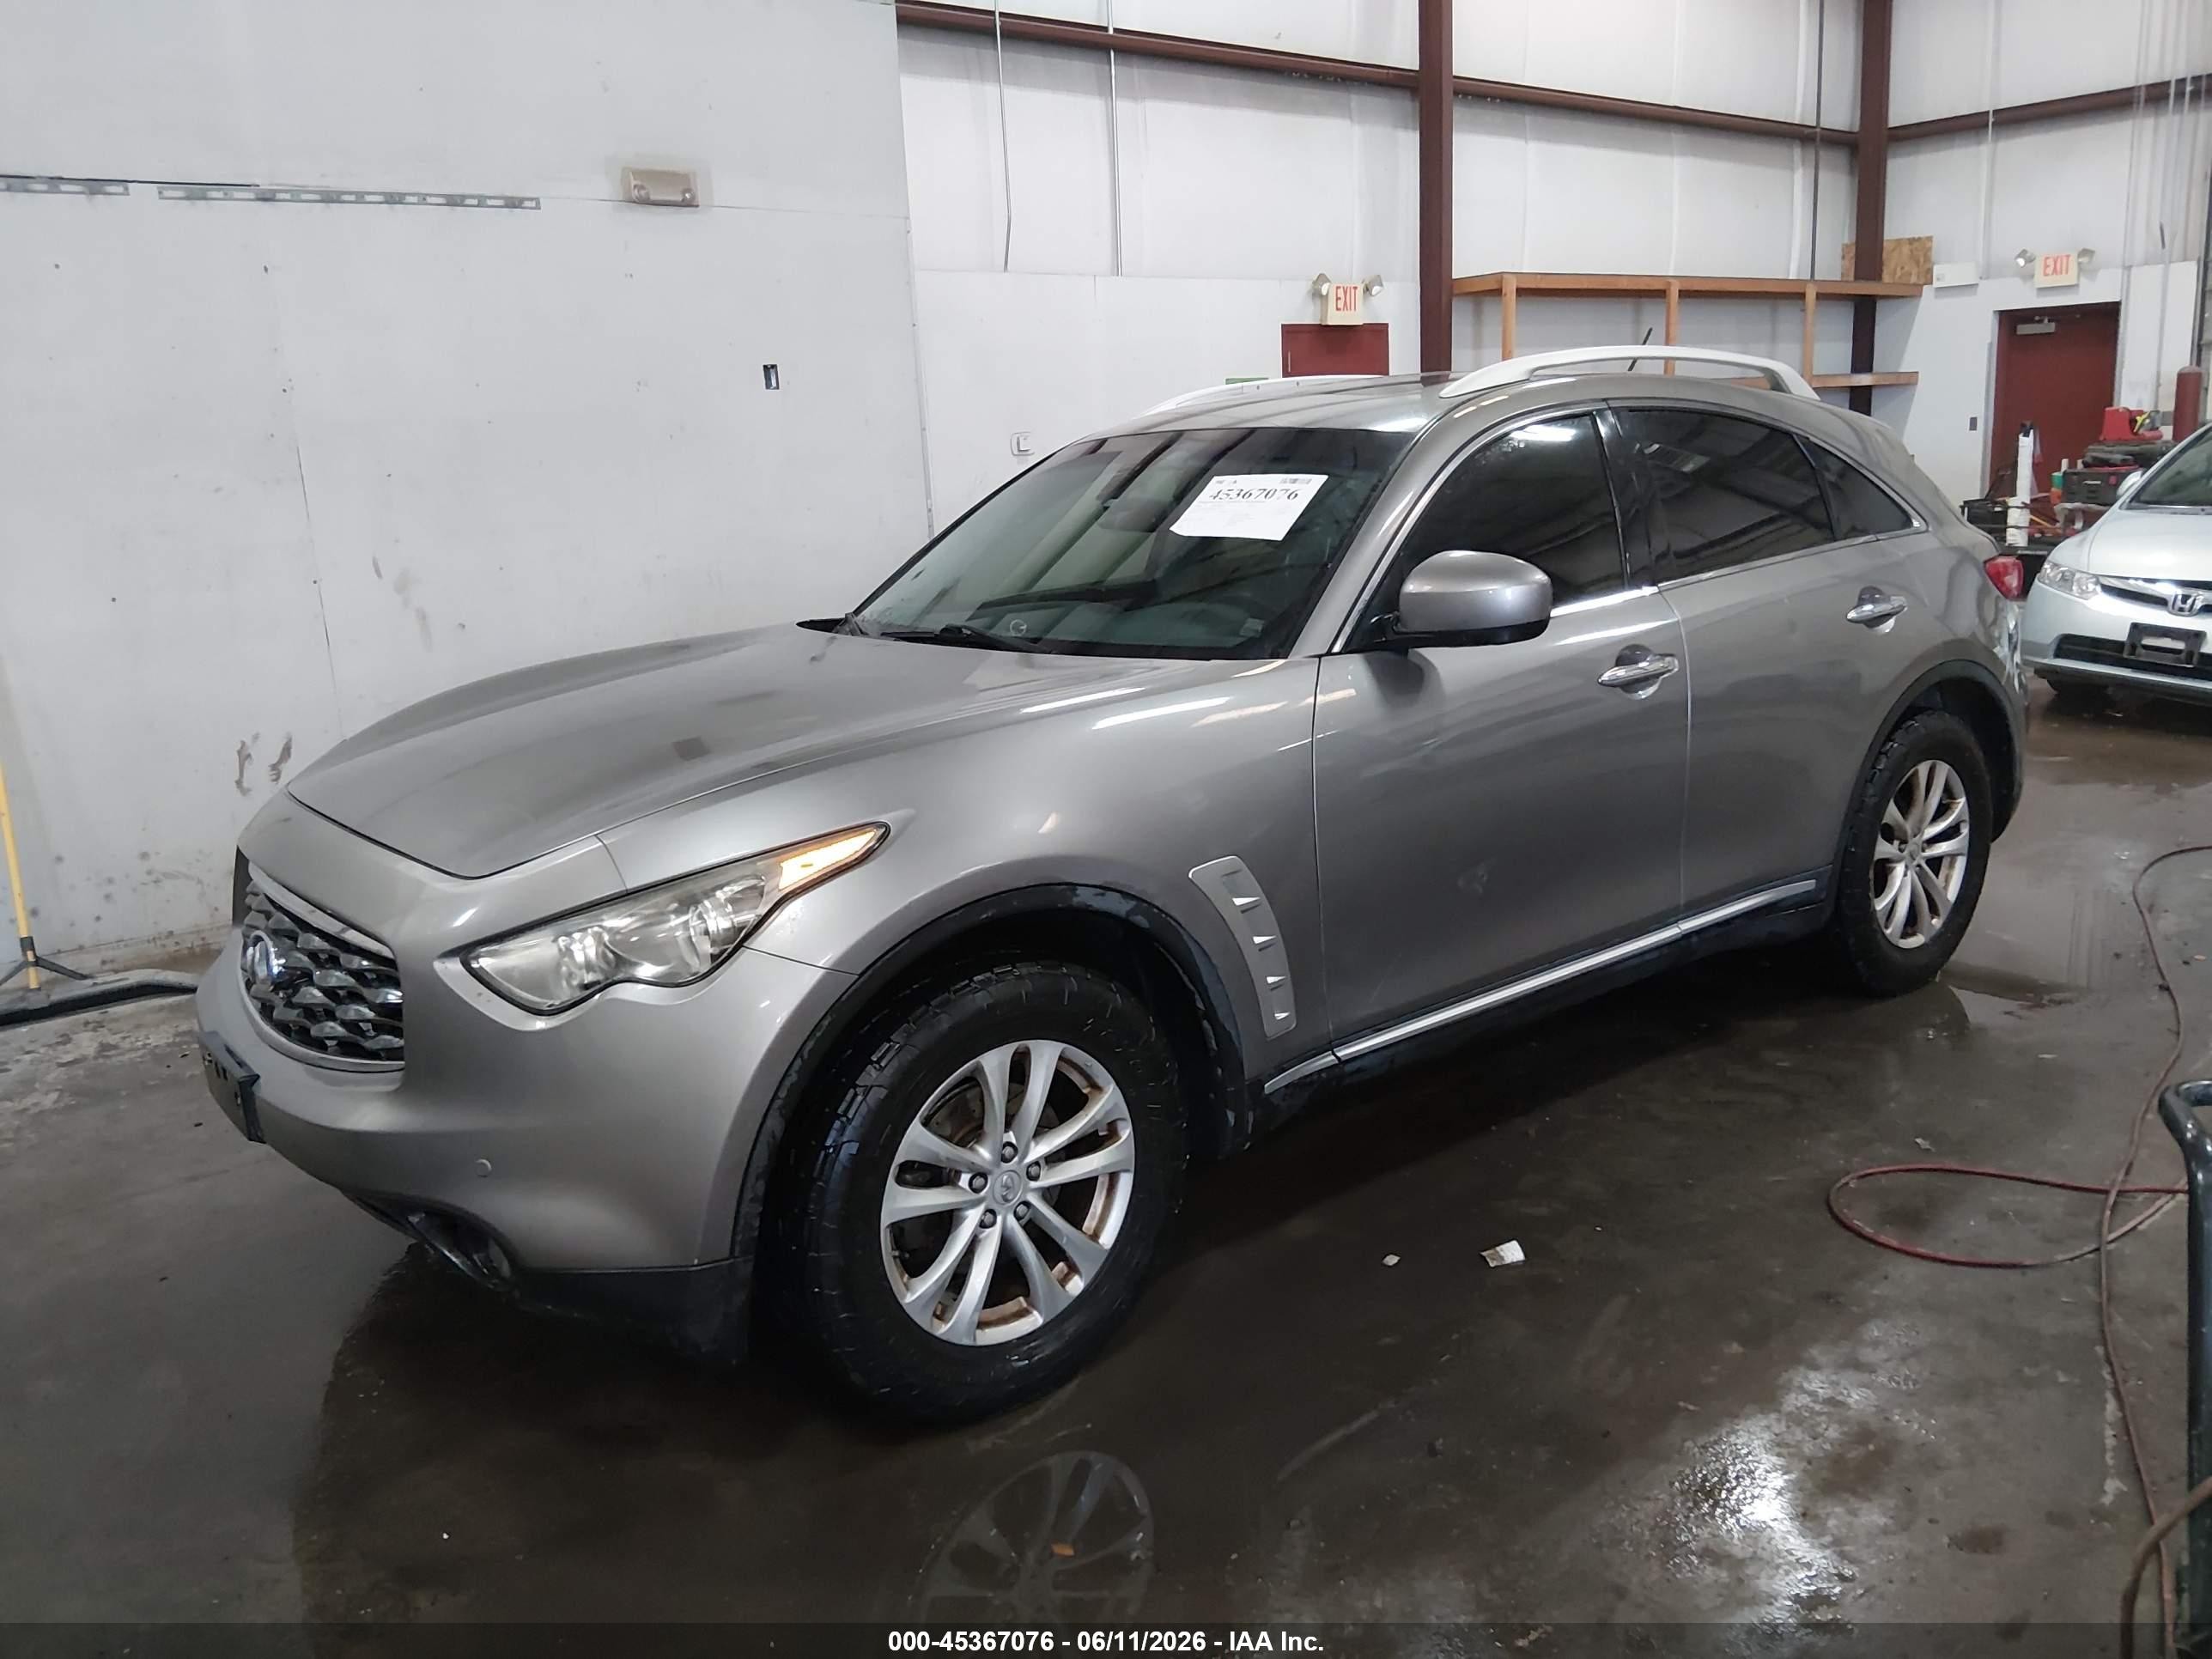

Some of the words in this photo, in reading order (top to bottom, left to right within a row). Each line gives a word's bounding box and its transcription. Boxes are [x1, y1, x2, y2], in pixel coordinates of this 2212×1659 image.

[2043, 253, 2071, 276] EXIT
[1334, 285, 1358, 312] EXIT
[1209, 488, 1299, 501] 45367076
